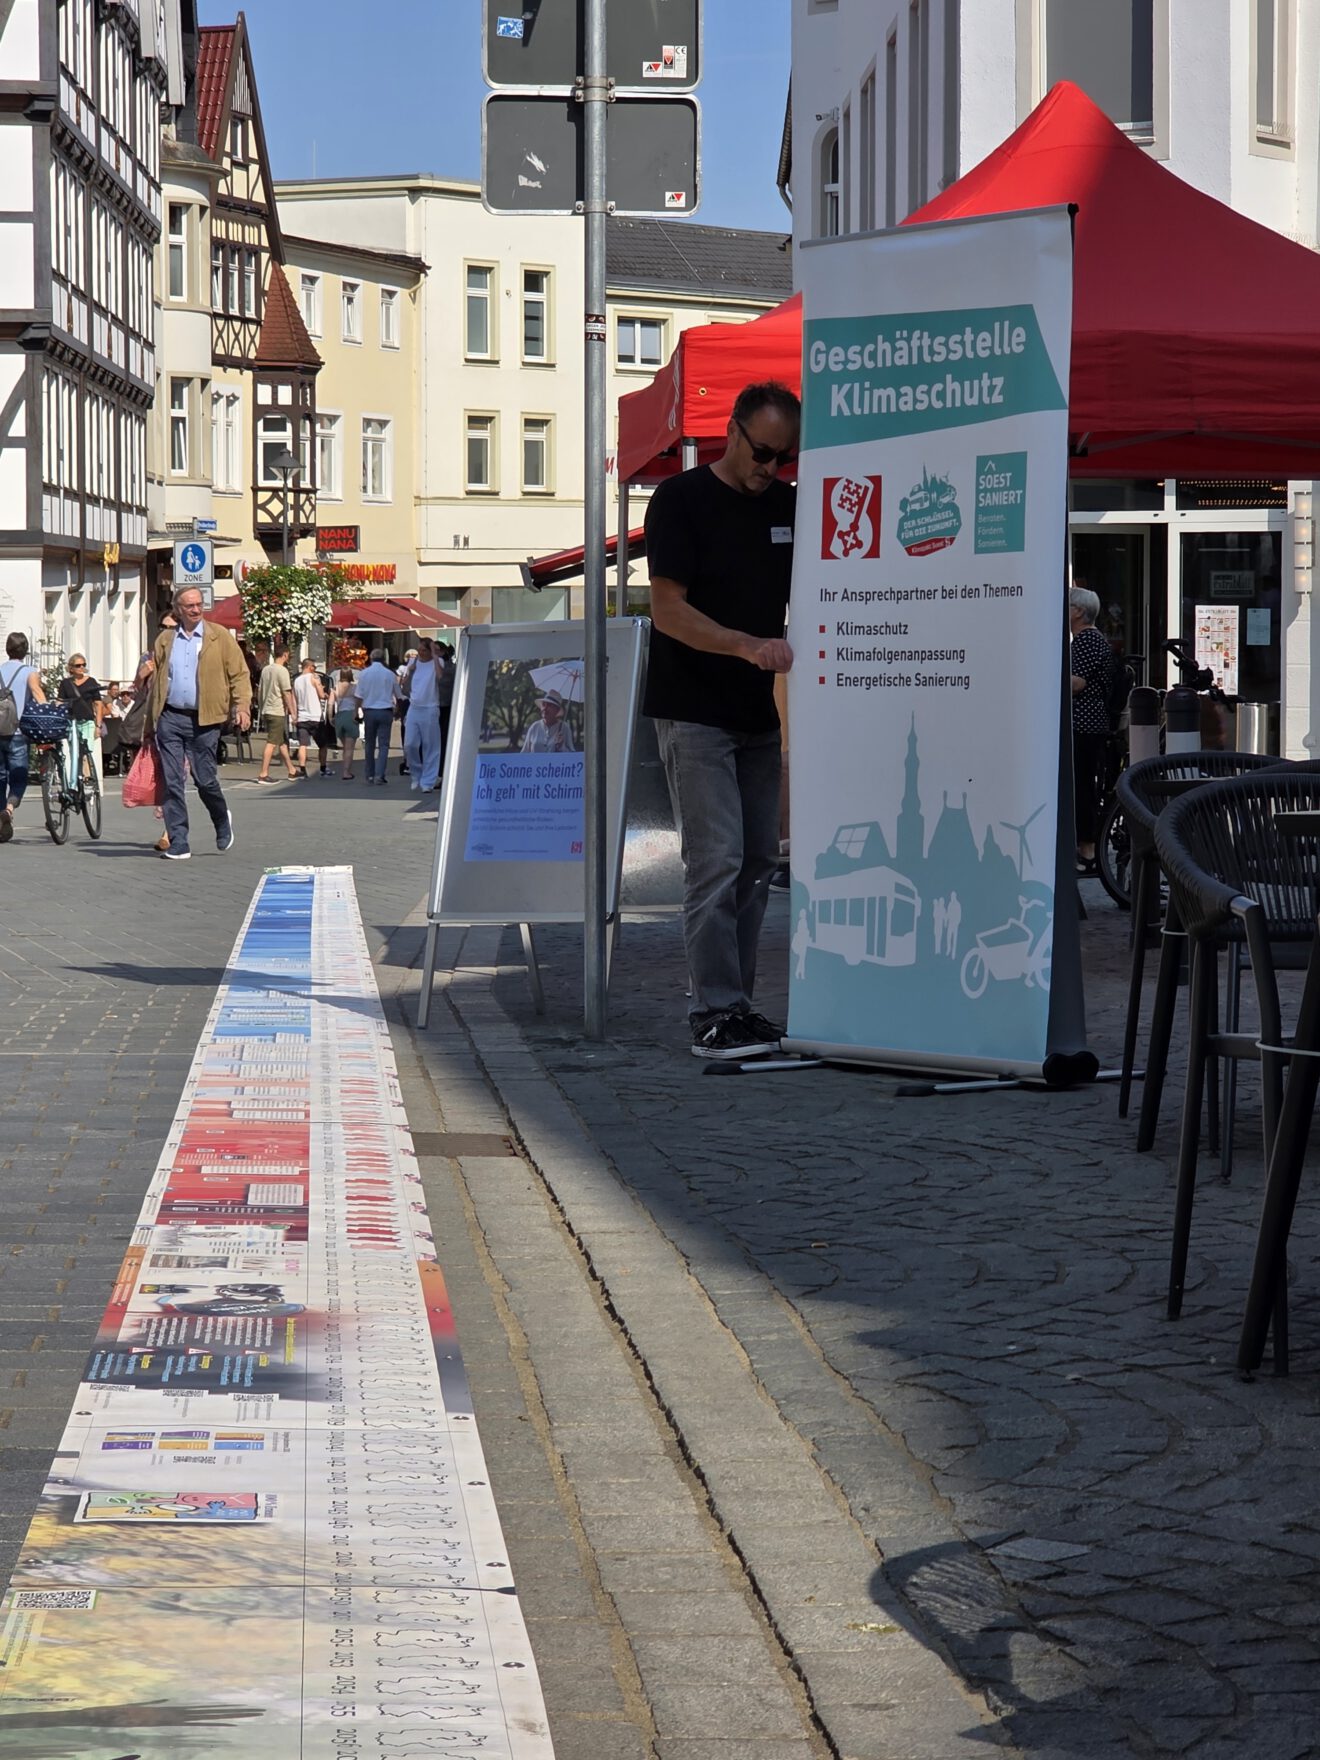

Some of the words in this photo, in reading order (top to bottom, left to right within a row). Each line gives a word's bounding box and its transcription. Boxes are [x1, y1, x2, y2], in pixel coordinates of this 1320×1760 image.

[809, 320, 1027, 374] Geschäftsstelle
[830, 372, 1005, 417] Klimaschutz
[978, 472, 1013, 490] SOEST
[978, 490, 1023, 508] SANIERT
[319, 528, 355, 539] NANU
[903, 521, 917, 530] DER
[319, 539, 356, 549] NANA
[184, 574, 204, 582] ZONE
[819, 587, 838, 603] Ihr
[840, 586, 939, 605] Ansprechpartner
[941, 584, 958, 600] bei
[960, 584, 980, 600] den
[983, 583, 1024, 599] Themen
[836, 621, 909, 636] Klimaschutz
[836, 647, 966, 664] Klimafolgenanpassung
[836, 672, 912, 690] Energetische
[914, 672, 970, 690] Sanierung
[479, 763, 497, 779] Die
[499, 762, 533, 779] Sonne
[535, 761, 584, 779] scheint?
[476, 784, 493, 800] Ich
[494, 784, 520, 803] geh'
[522, 783, 541, 800] mit
[329, 1587, 352, 1606] 2050
[330, 1628, 354, 1648] 2052
[329, 1651, 354, 1667] 2053
[331, 1675, 356, 1695] 2054
[331, 1728, 363, 1748] 2056
